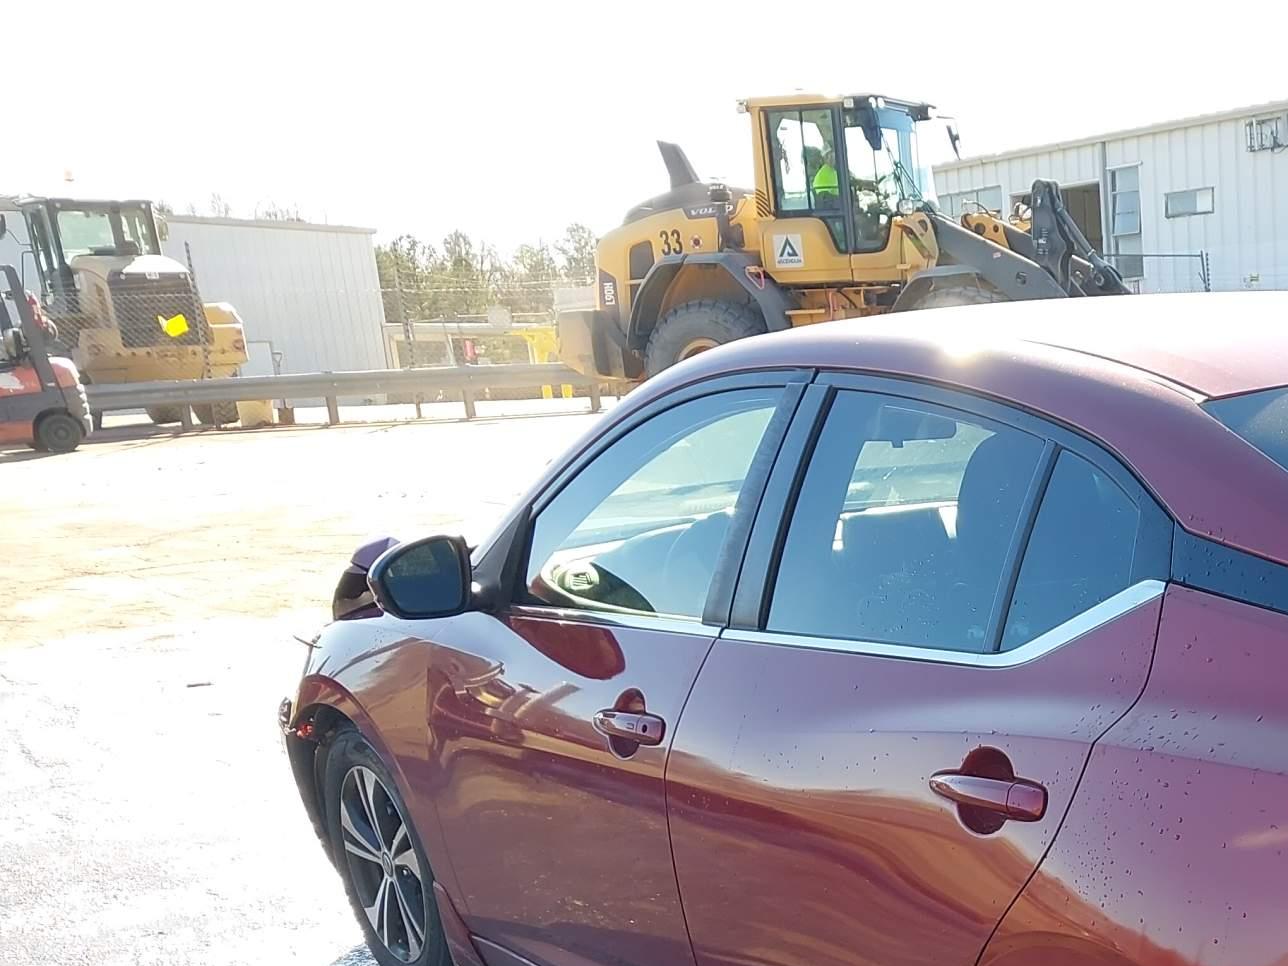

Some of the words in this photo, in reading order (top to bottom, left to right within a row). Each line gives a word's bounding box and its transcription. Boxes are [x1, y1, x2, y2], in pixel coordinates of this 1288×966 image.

[690, 204, 734, 216] VOLO
[659, 228, 684, 256] 33
[603, 282, 616, 305] L90H
